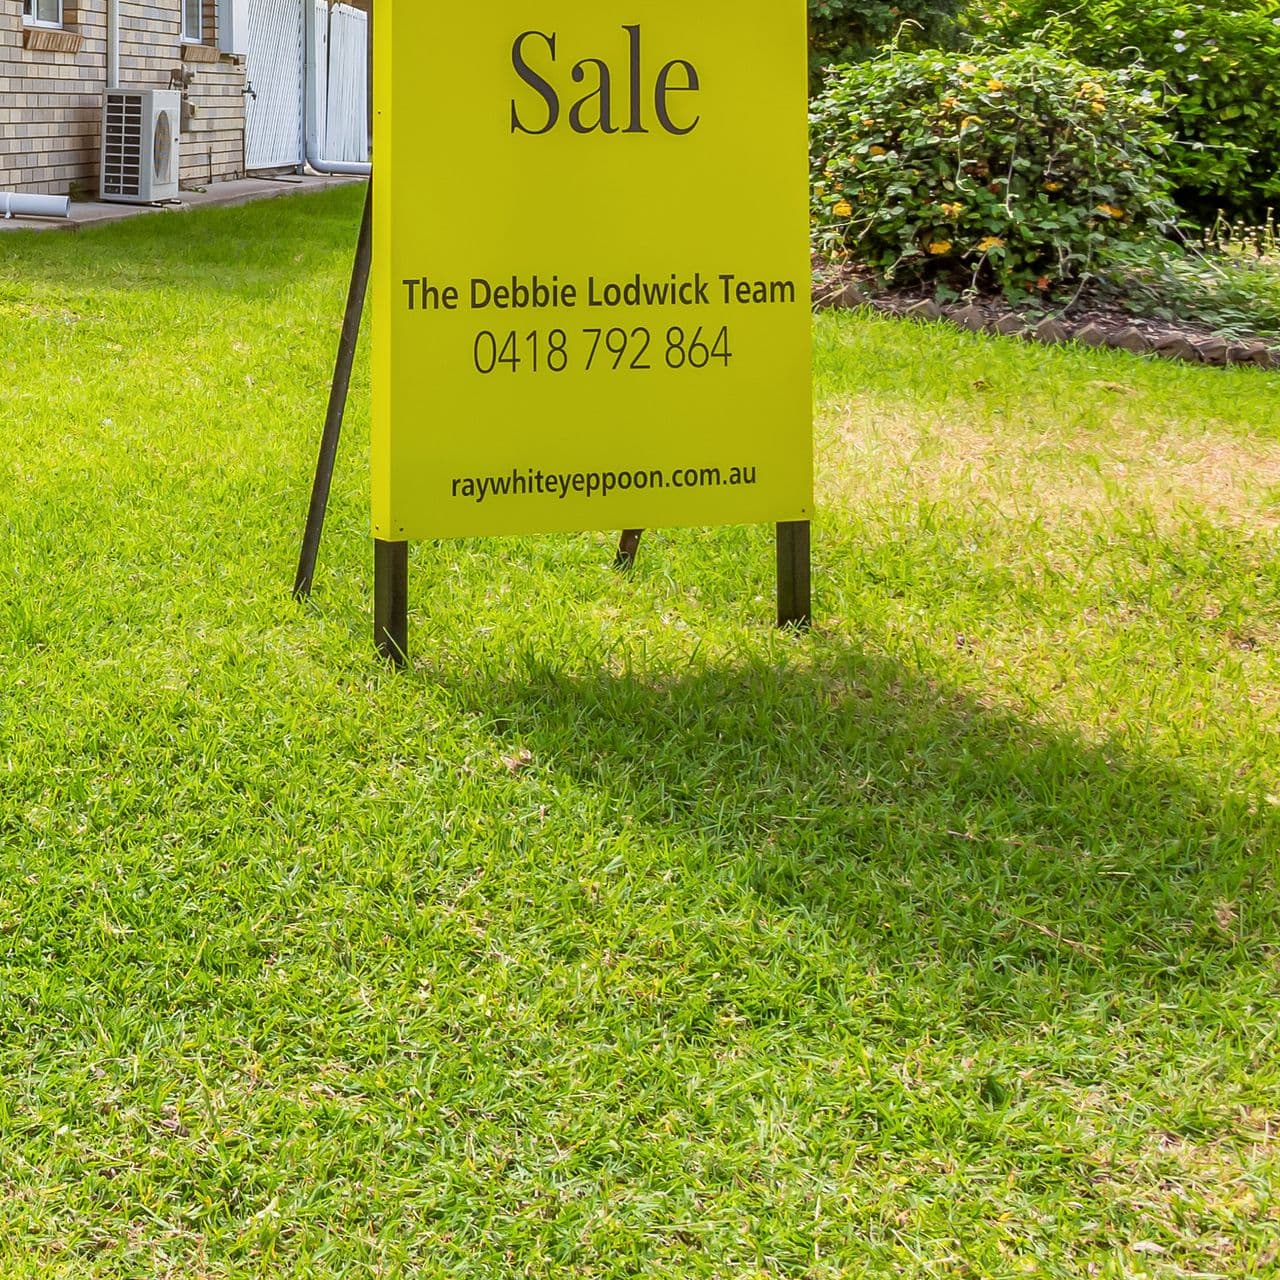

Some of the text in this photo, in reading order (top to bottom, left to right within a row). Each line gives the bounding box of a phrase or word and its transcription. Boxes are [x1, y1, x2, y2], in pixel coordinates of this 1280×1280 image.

[510, 24, 701, 136] Sale
[402, 273, 796, 310] The Debbie Lodwick Team
[473, 326, 733, 374] 0418 792 864
[451, 464, 757, 502] raywhiteyeppoon.com.au
